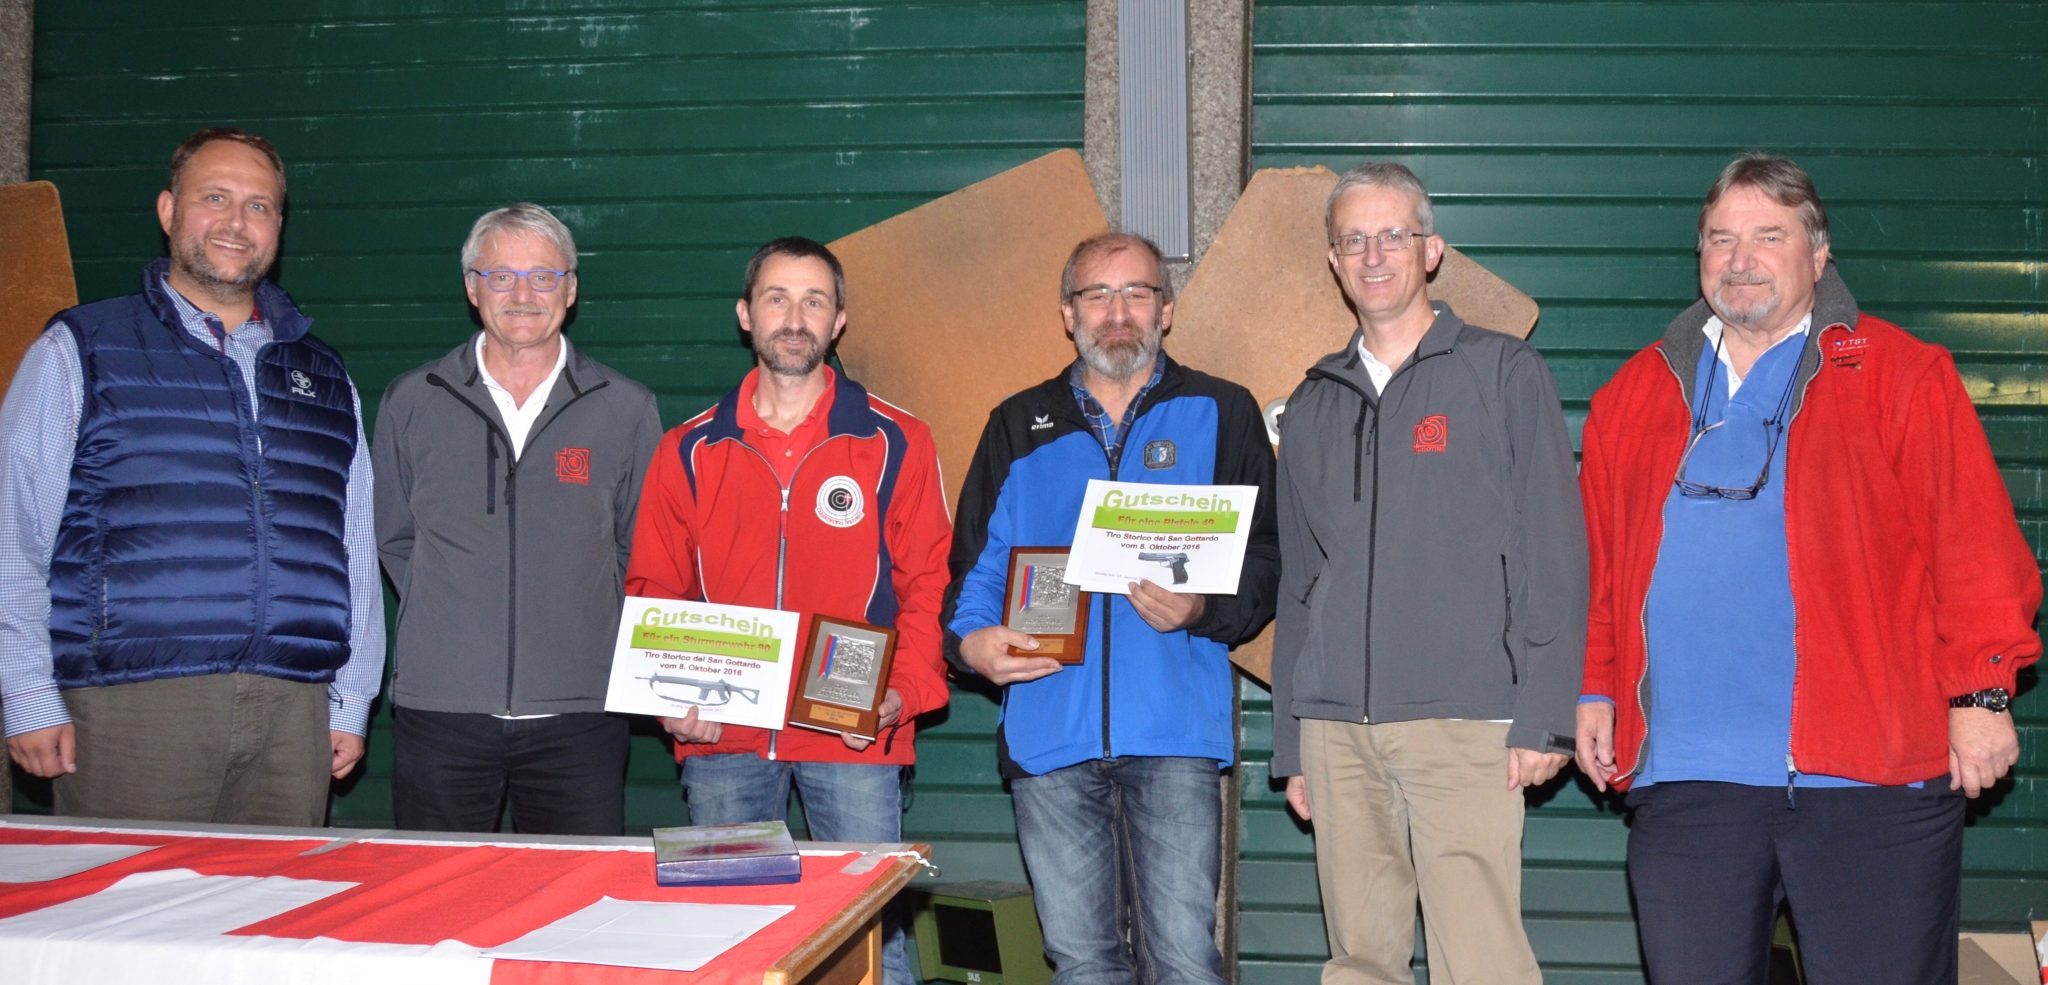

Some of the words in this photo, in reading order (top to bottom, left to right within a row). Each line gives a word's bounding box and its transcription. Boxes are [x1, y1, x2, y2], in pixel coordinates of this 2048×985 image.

[1103, 489, 1232, 518] Gutschein
[1117, 515, 1136, 524] Für
[1139, 517, 1160, 525] eine
[1163, 517, 1199, 526] Pistole
[1106, 531, 1121, 539] Tiro
[1123, 533, 1152, 541] Storico
[641, 606, 774, 642] Gutschein
[642, 632, 661, 641] Für
[664, 634, 680, 642] ein
[683, 634, 755, 650] Sturmgewehr
[645, 651, 660, 659] Tiro
[662, 652, 691, 661] Storico
[693, 654, 706, 663] del
[707, 656, 723, 664] San
[725, 658, 761, 669] Gottardo
[688, 664, 721, 674] Oktober
[723, 668, 742, 677] 2016
